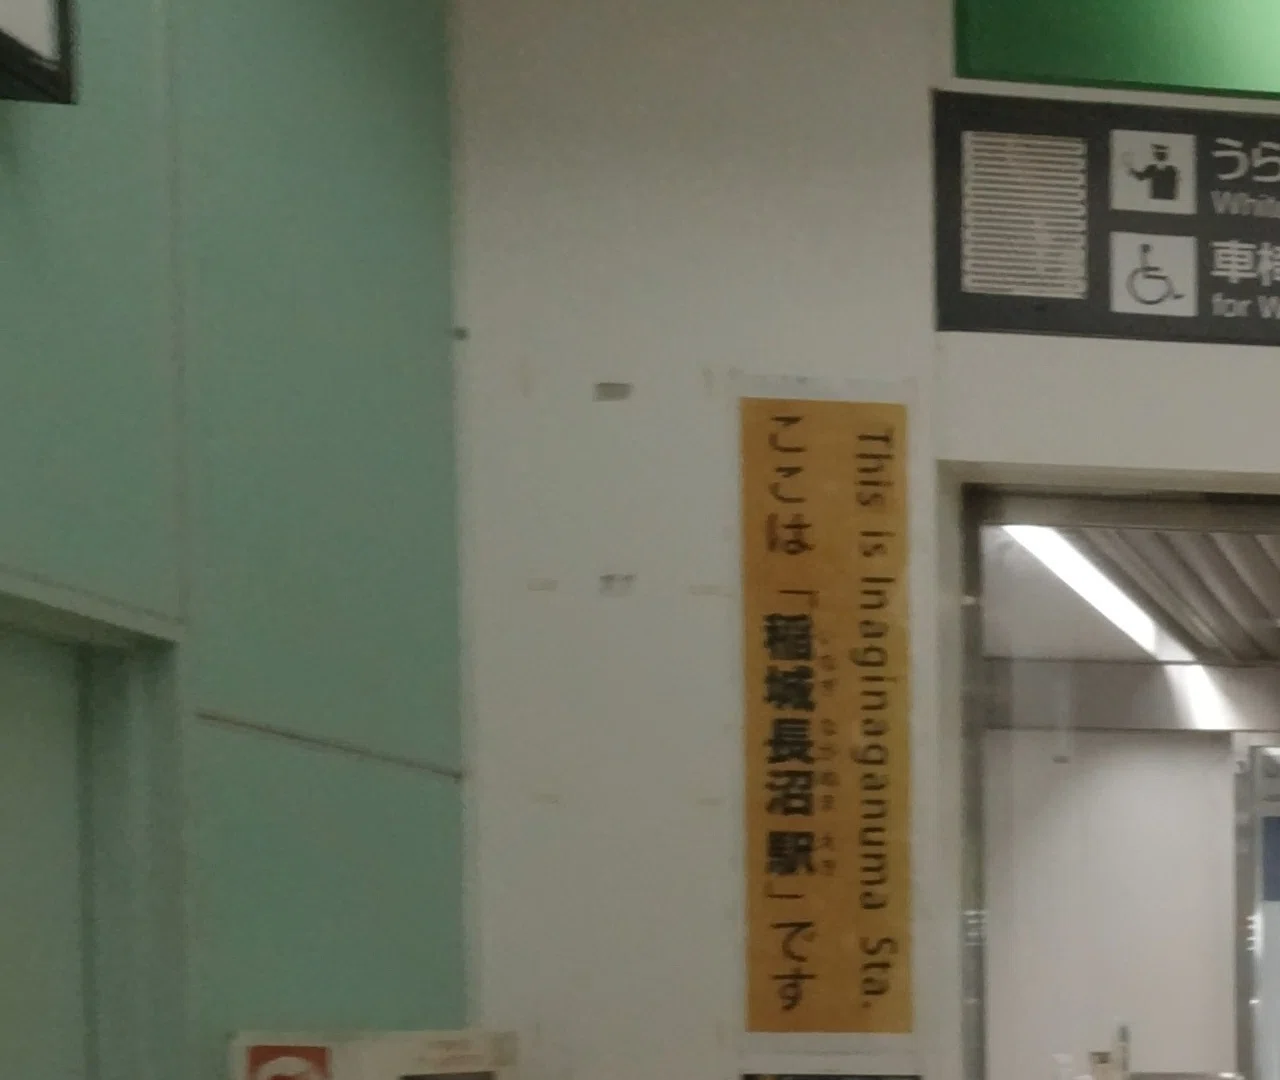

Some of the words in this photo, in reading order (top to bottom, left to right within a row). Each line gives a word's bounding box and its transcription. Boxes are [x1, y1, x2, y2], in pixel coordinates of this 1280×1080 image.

[1211, 292, 1252, 318] for
[855, 427, 895, 506] This
[859, 532, 896, 557] is
[848, 577, 898, 909] Inaginaganuma
